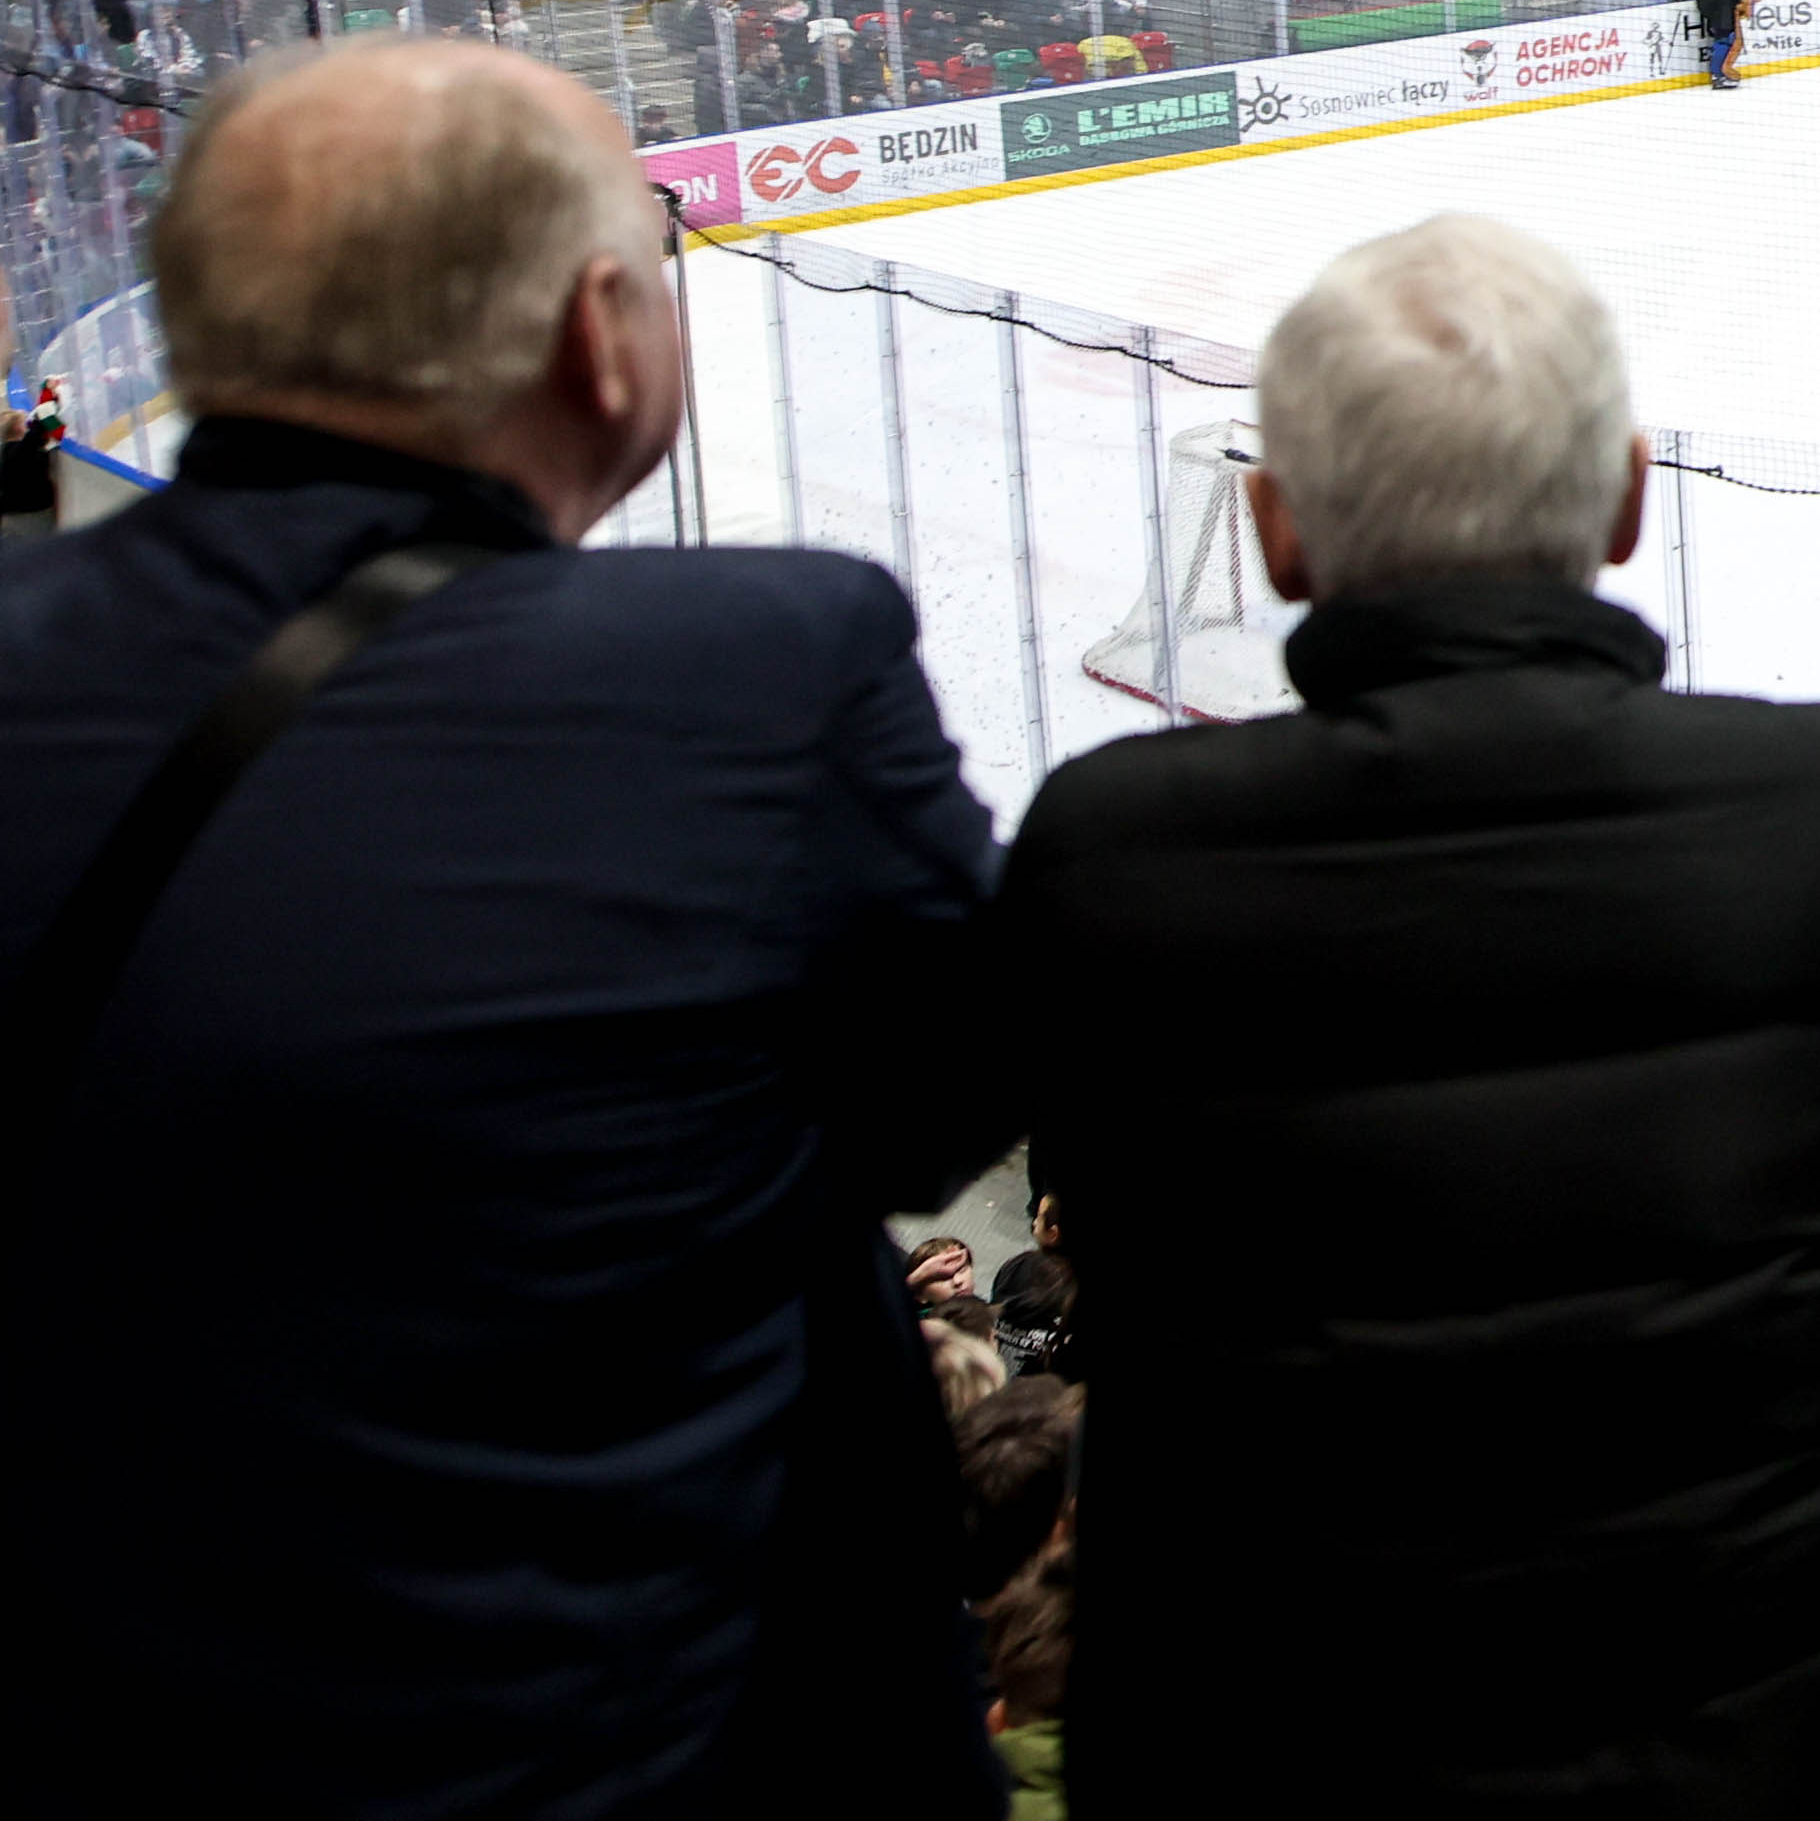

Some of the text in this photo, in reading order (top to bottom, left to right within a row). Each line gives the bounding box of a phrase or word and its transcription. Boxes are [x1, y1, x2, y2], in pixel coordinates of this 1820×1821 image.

[1516, 28, 1621, 62] AGENCJA
[1517, 52, 1628, 88] OCHRONY
[1299, 78, 1449, 120] Sosnowiec łączy
[879, 123, 977, 164] BĘDZIN
